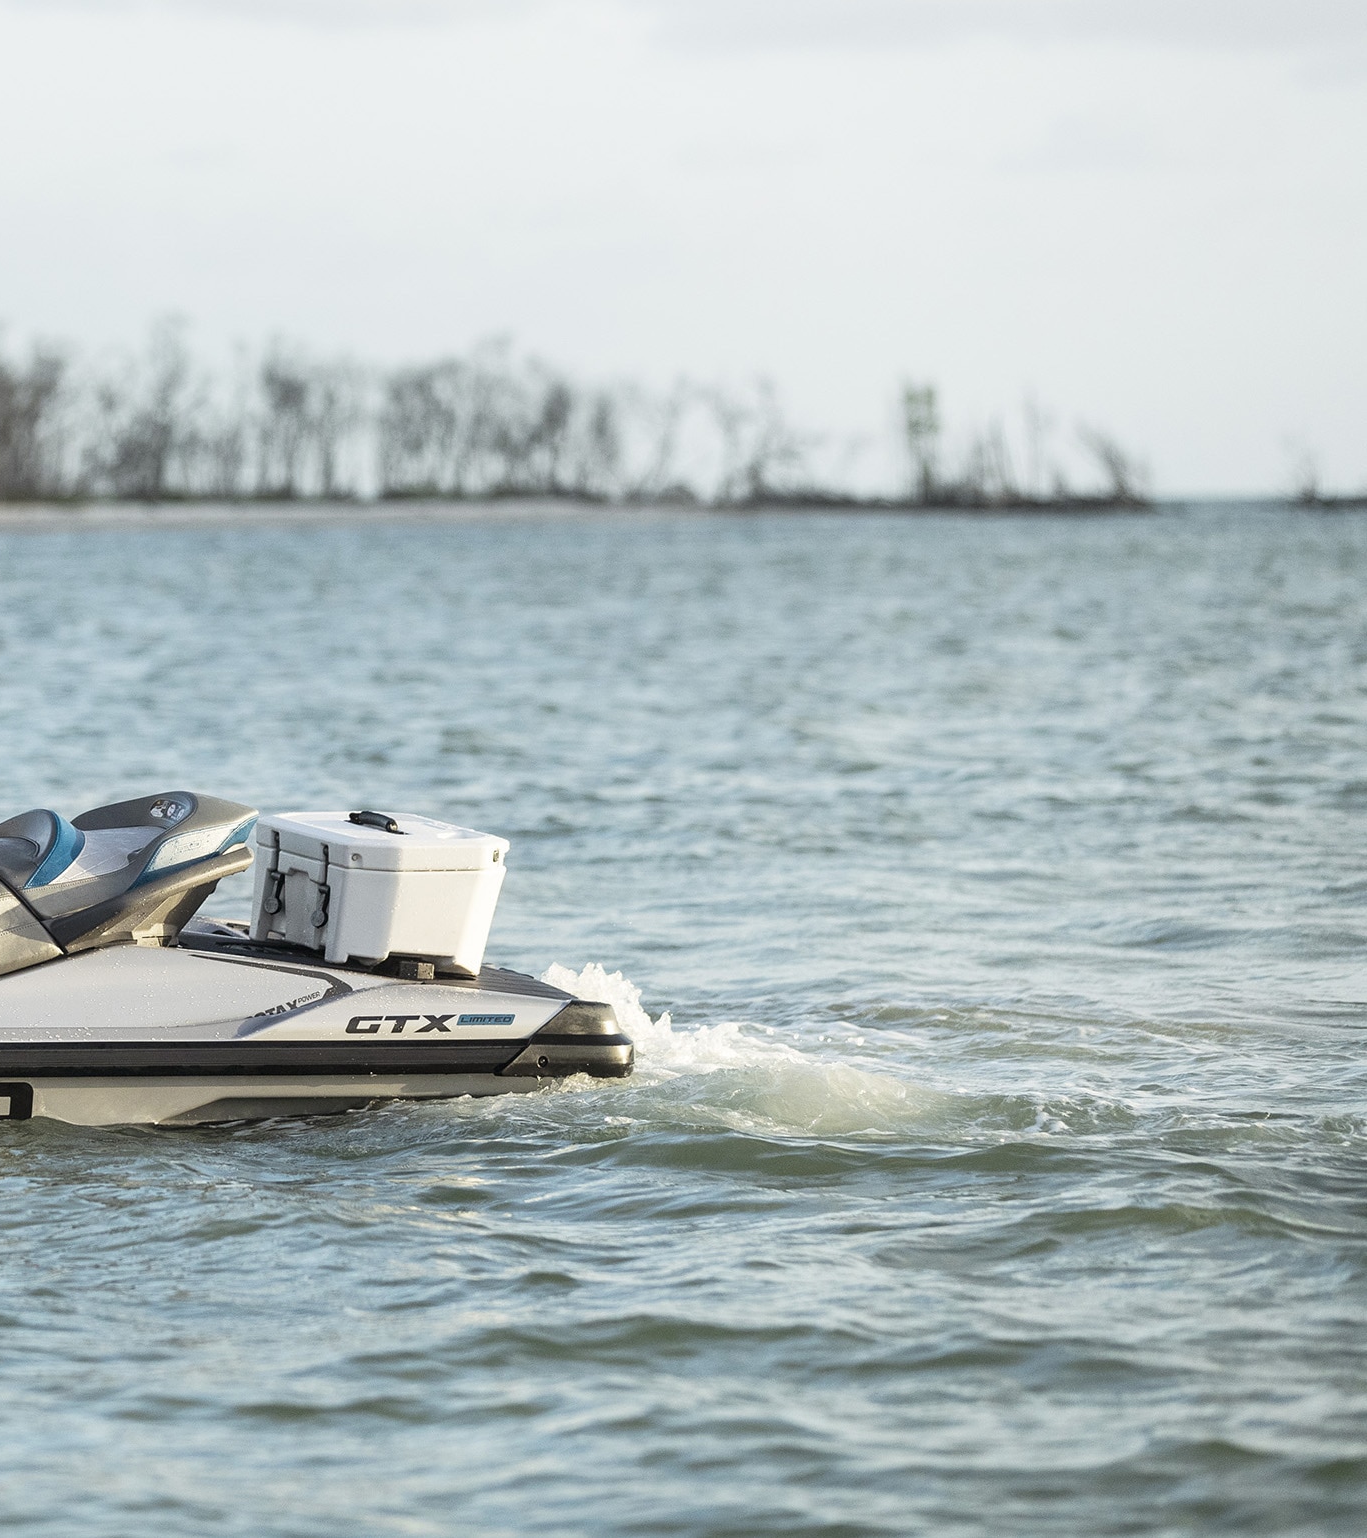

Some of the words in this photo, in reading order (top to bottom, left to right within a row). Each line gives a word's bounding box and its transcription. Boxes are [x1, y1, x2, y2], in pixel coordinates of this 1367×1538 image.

[243, 999, 298, 1020] TAX
[297, 991, 321, 1004] POWER
[345, 1014, 458, 1034] GTX
[460, 1016, 513, 1024] LIMITED
